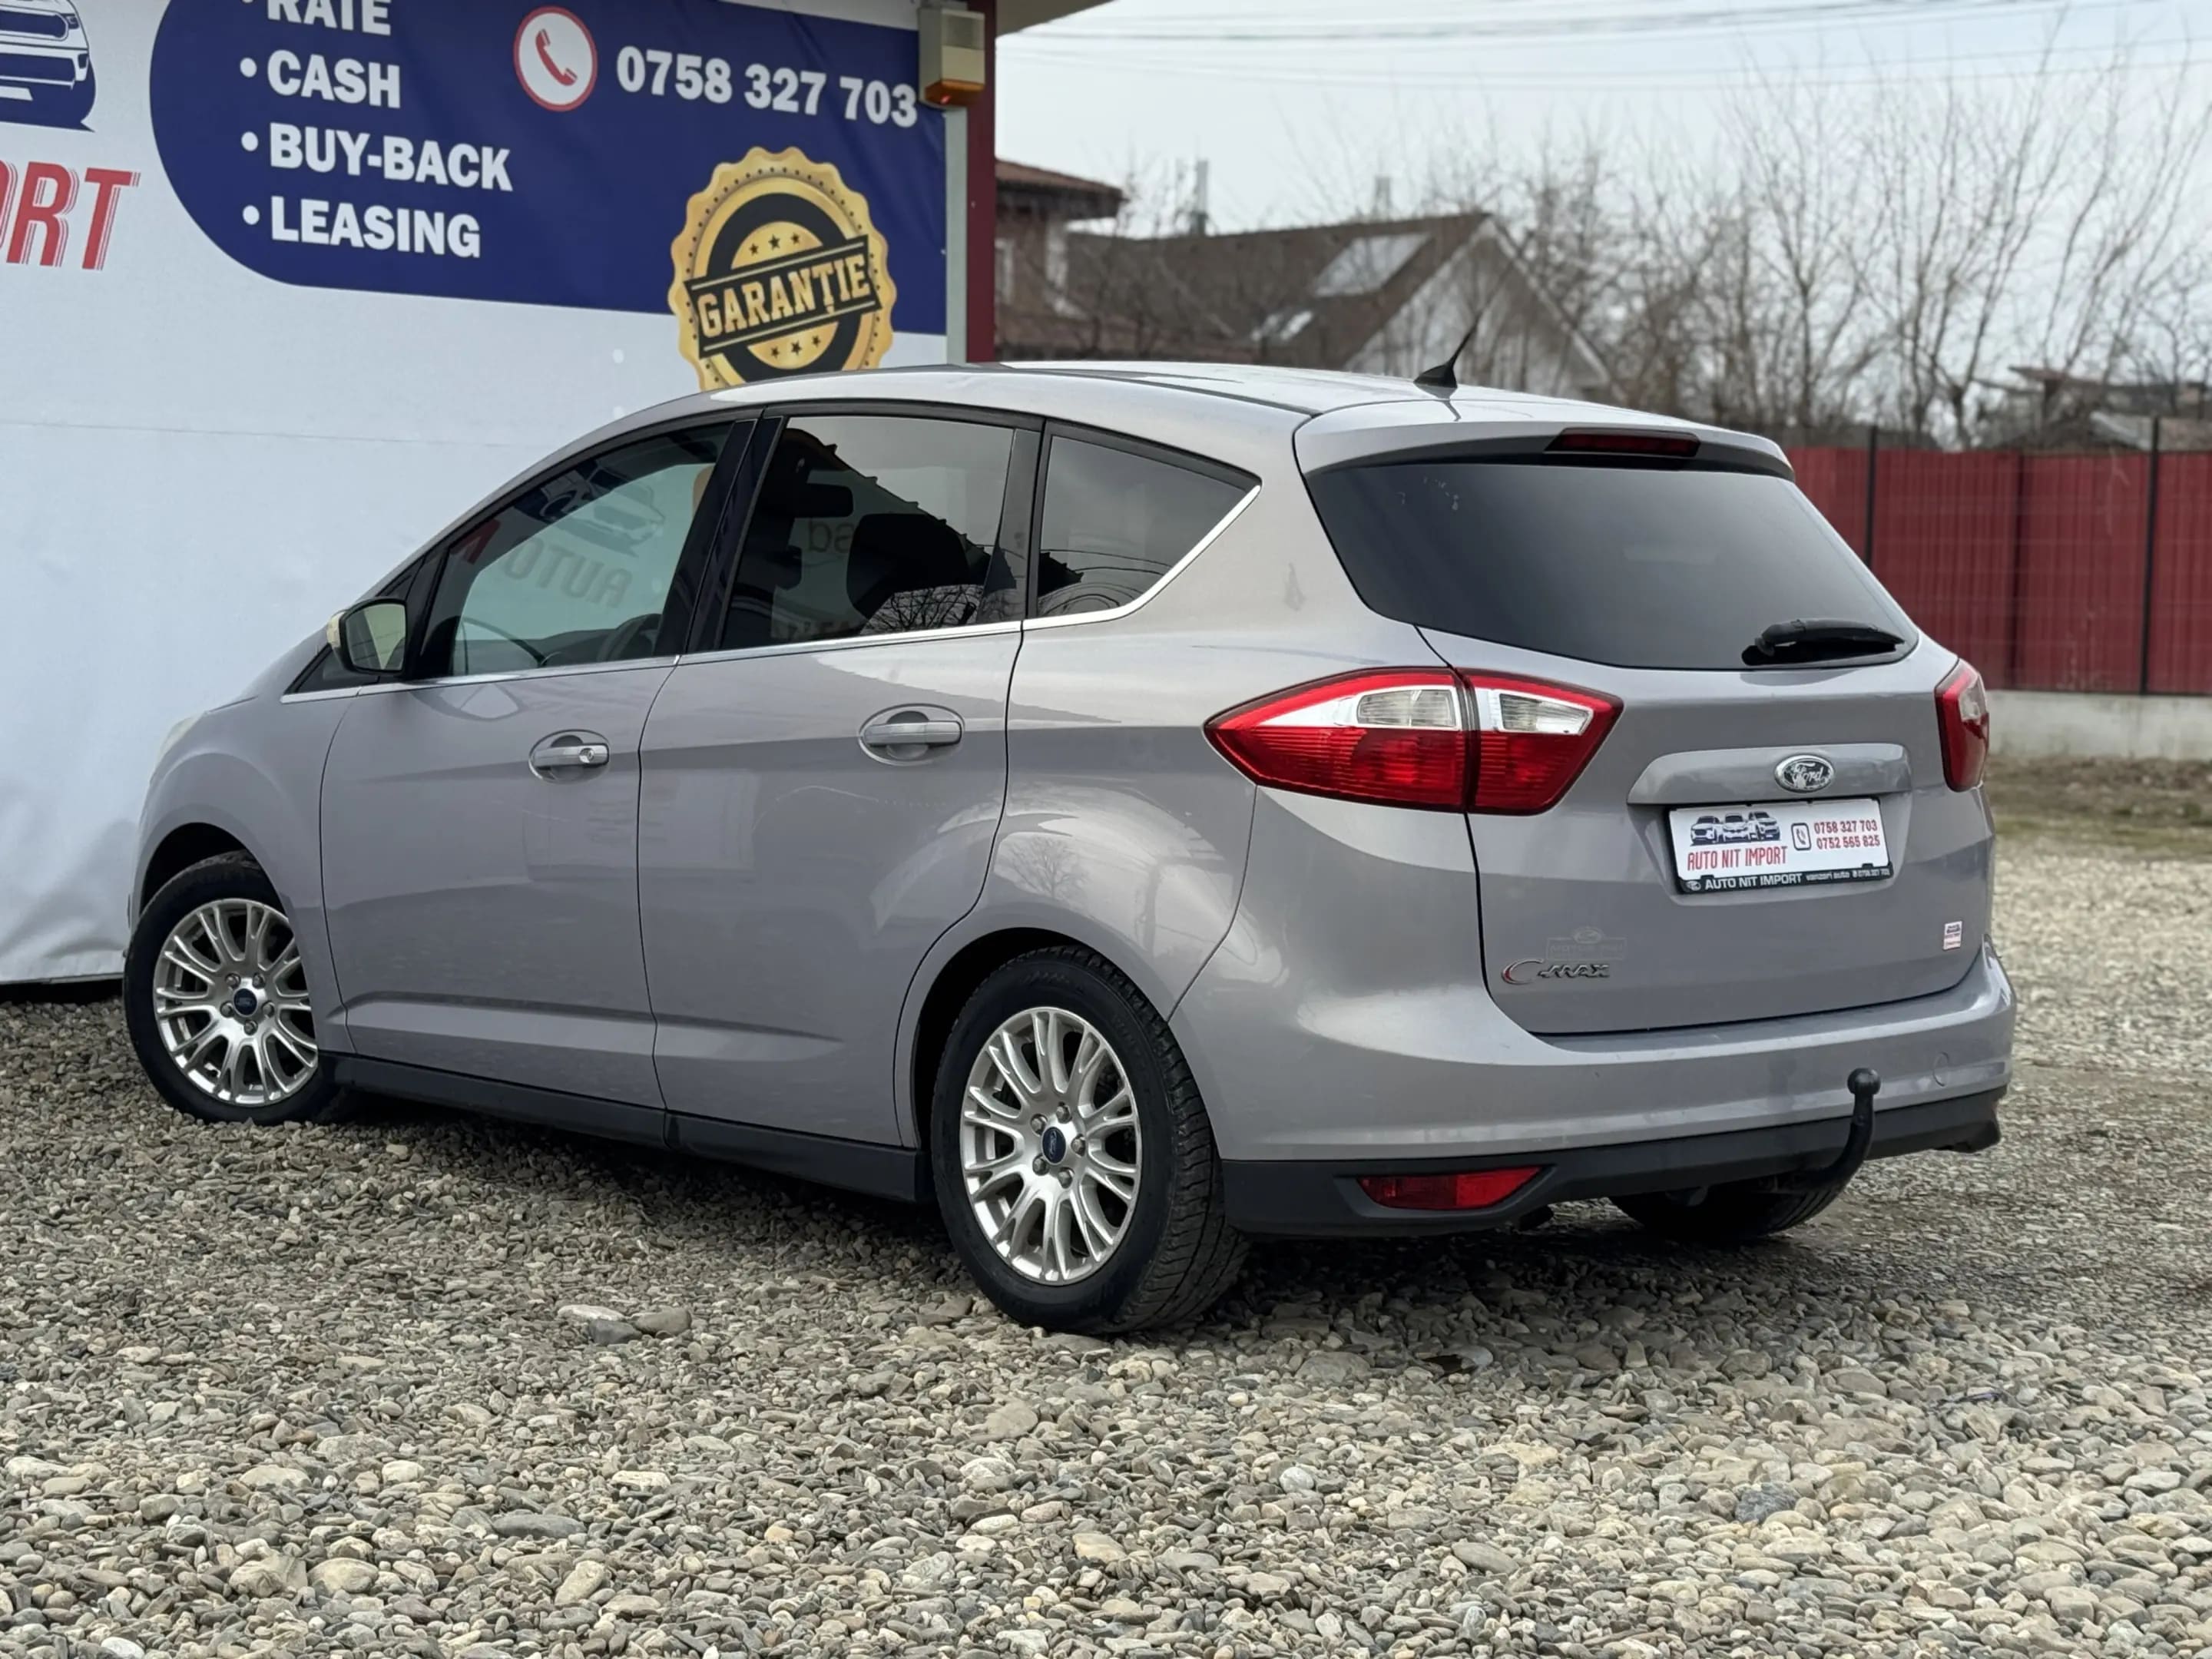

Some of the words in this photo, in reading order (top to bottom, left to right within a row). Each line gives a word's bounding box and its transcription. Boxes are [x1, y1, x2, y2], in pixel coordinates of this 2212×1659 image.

[267, 49, 400, 108] CASH
[617, 45, 733, 104] 0758
[744, 64, 826, 115] 327
[839, 76, 918, 127] 703
[270, 122, 513, 191] BUY-BACK
[271, 196, 481, 258] LEASING
[1813, 820, 1839, 834] 0758
[1839, 820, 1857, 833] 327
[1859, 819, 1878, 832] 703
[1816, 836, 1841, 849] 0752
[1862, 834, 1881, 847] 825
[1687, 850, 1718, 871] AUTO
[1721, 849, 1741, 869] NIT
[1744, 846, 1788, 867] IMPORT
[1704, 878, 1737, 890] AUTO
[1738, 876, 1758, 887] NIT
[1760, 873, 1803, 886] IMPORT
